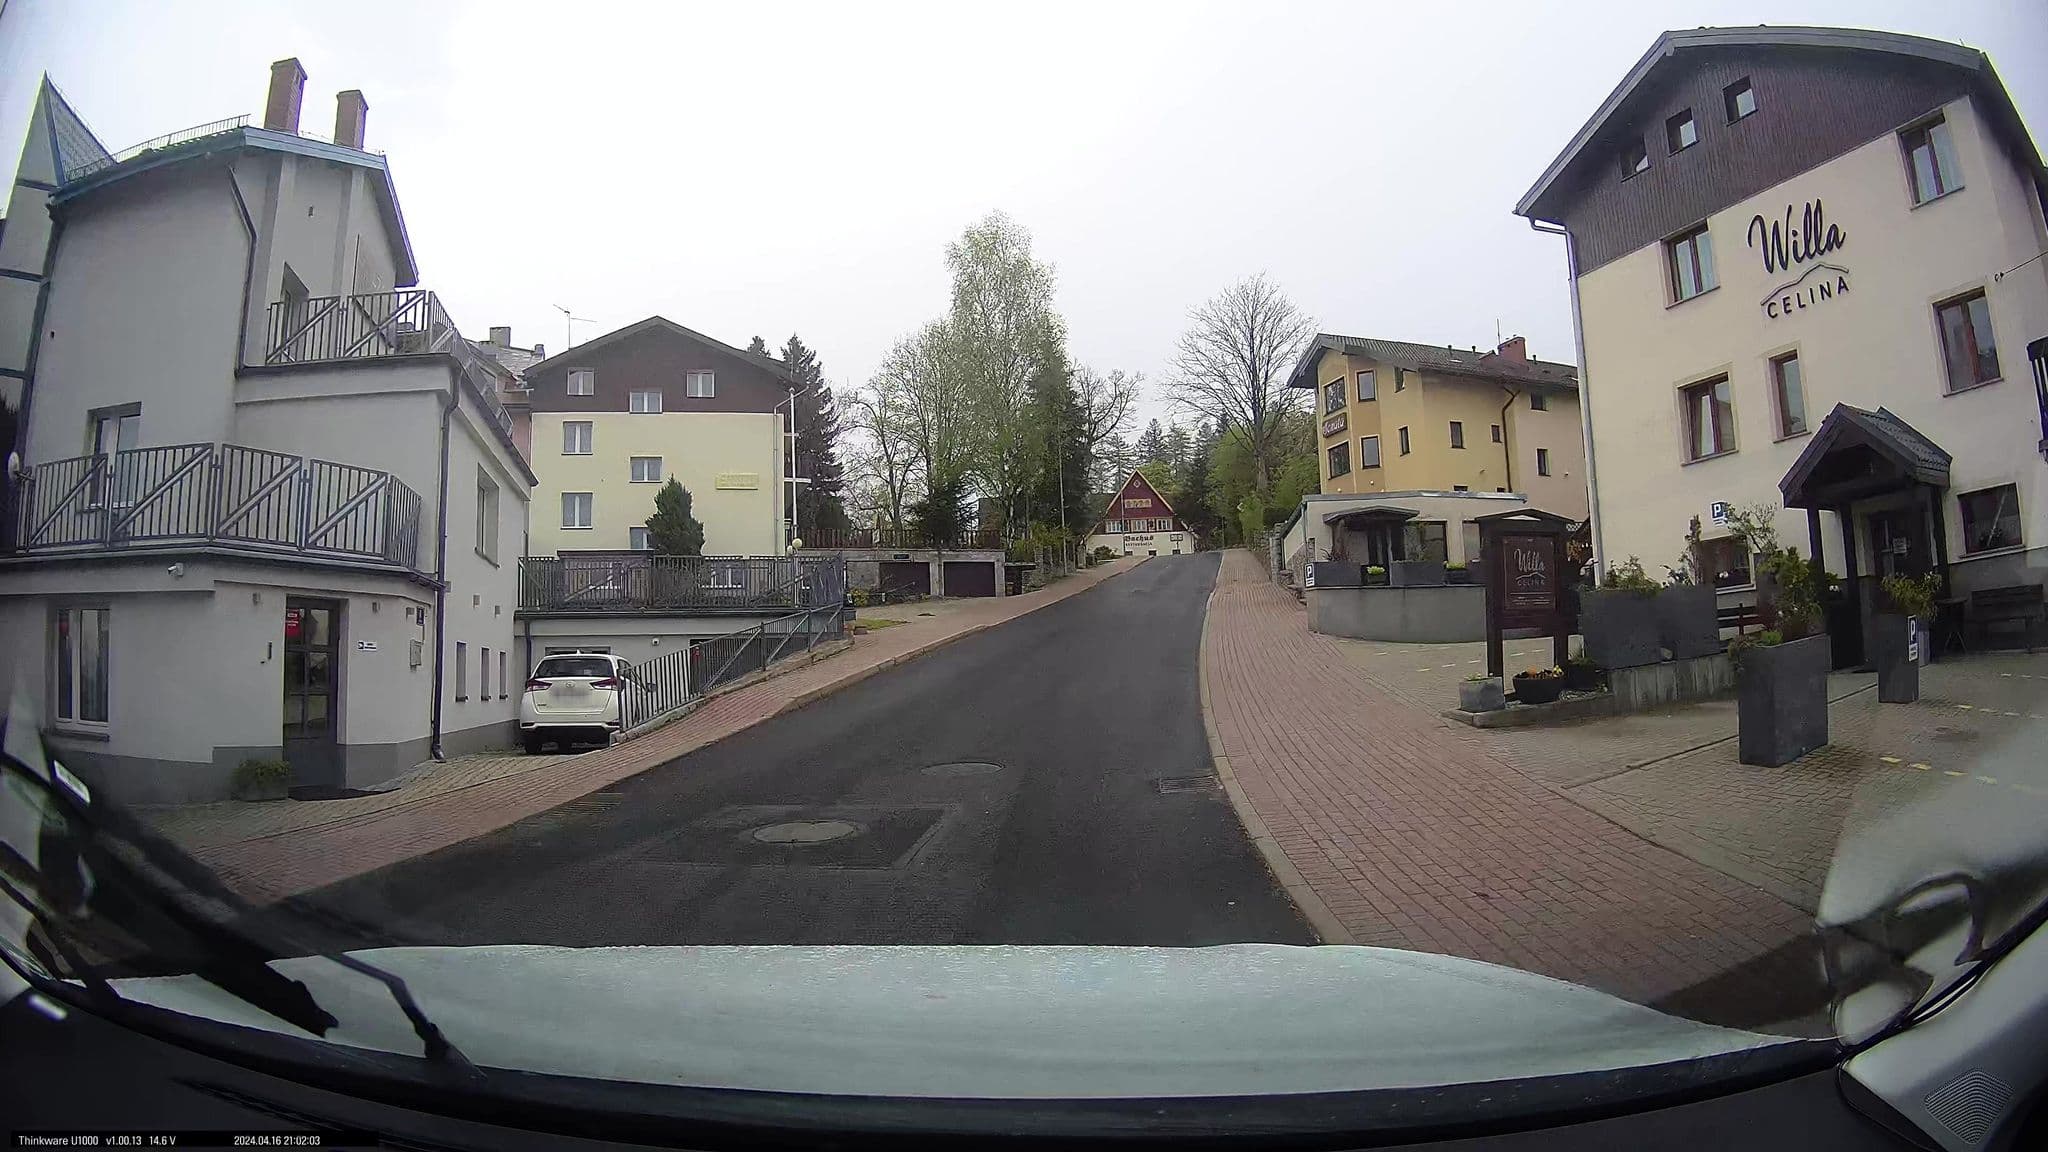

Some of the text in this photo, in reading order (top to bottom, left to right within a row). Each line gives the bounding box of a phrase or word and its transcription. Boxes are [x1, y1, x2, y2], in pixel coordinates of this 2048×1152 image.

[1747, 198, 1846, 274] Willa
[1767, 276, 1849, 318] CELINA
[1713, 503, 1722, 517] P
[1124, 534, 1154, 542] Bachus
[1306, 565, 1312, 578] P
[1513, 548, 1545, 573] Willa
[1910, 619, 1916, 641] P
